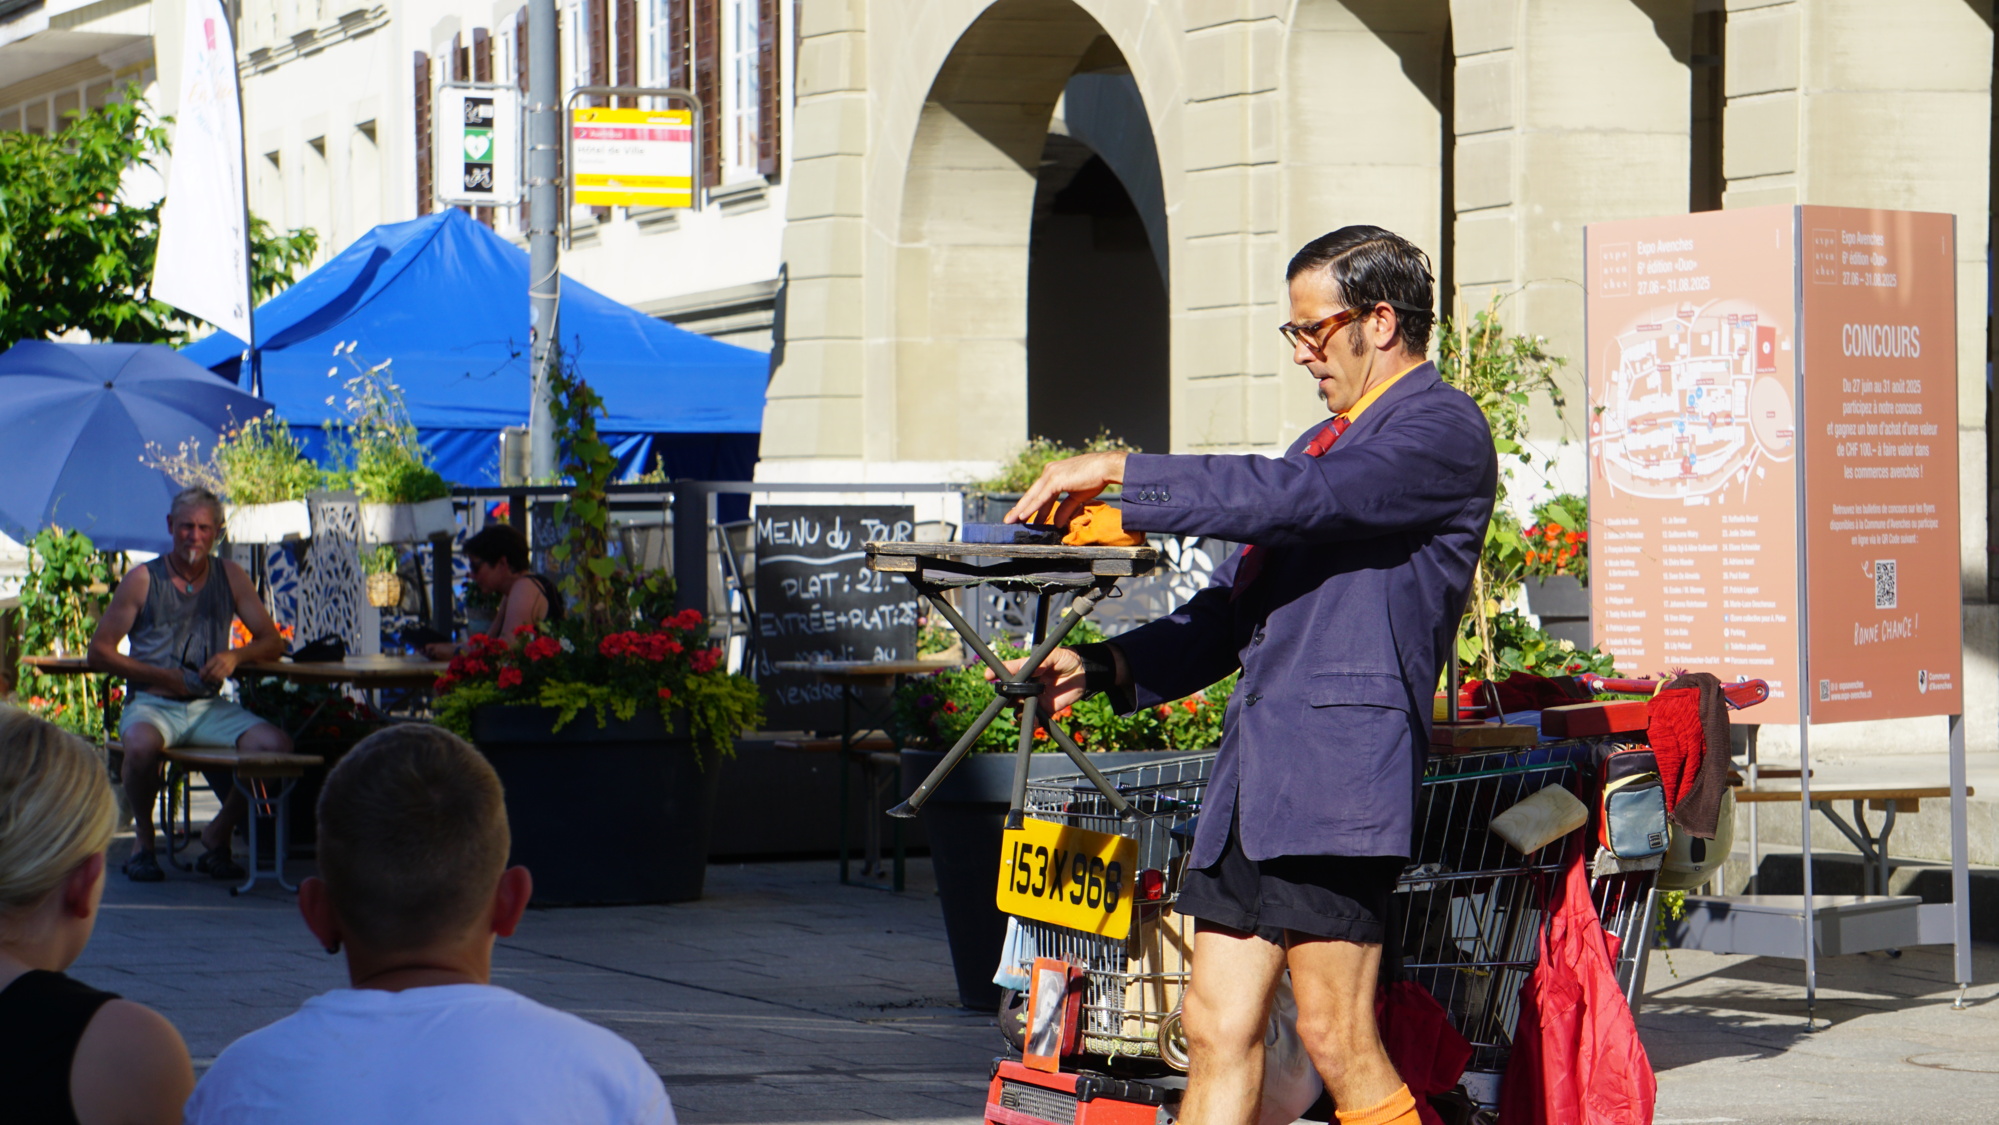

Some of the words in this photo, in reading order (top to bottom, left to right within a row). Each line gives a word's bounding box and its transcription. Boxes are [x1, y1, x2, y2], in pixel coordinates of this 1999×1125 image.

[1637, 240, 1656, 257] Expo
[1657, 237, 1694, 253] Avenches
[1841, 230, 1856, 247] Expo
[1856, 231, 1885, 247] Avenches
[1849, 250, 1869, 266] édition
[1647, 259, 1673, 275] édition
[1637, 280, 1660, 295] 27.06
[1667, 276, 1711, 293] 31.08.2025
[1842, 271, 1859, 286] 27.06
[1865, 272, 1897, 287] 31.08.2025
[1842, 323, 1920, 358] CONCOURS
[1842, 378, 1852, 393] Du
[1852, 378, 1861, 393] 27
[1861, 378, 1873, 396] juin
[1873, 381, 1882, 393] au
[1883, 378, 1890, 393] 31
[1892, 379, 1905, 393] août
[1906, 379, 1922, 394] 2025
[1842, 400, 1872, 417] participez
[1873, 400, 1878, 415] à
[1879, 401, 1894, 415] notre
[1895, 402, 1922, 415] concours
[1827, 421, 1833, 436] et
[1834, 423, 1856, 439] gagnez
[1857, 424, 1865, 436] un
[1866, 421, 1879, 436] bon
[1879, 421, 1900, 436] d'achat
[1901, 421, 1919, 436] d'une
[1920, 421, 1938, 436] valeur
[1836, 442, 1845, 457] de
[1845, 442, 1859, 457] CHF
[1877, 442, 1882, 457] à
[1882, 442, 1897, 457] faire
[1897, 442, 1914, 457] valoir
[1915, 442, 1930, 457] dans
[1843, 464, 1853, 479] les
[1854, 466, 1889, 479] commerces
[1890, 464, 1920, 479] avenchois
[1832, 503, 1855, 515] Retrouvez
[1862, 503, 1881, 514] bulletins
[1888, 504, 1908, 514] concours
[757, 516, 820, 547] MENU
[826, 515, 851, 550] du
[860, 519, 913, 546] JOUR
[1829, 518, 1855, 532] disponibles
[1864, 518, 1886, 530] Commune
[1917, 517, 1939, 531] participez
[1881, 533, 1889, 545] QR
[1889, 533, 1900, 544] Code
[781, 572, 839, 599] PLAT
[1854, 621, 1878, 646] BONNE
[1881, 616, 1912, 642] CHANCE
[1928, 672, 1951, 681] Commune
